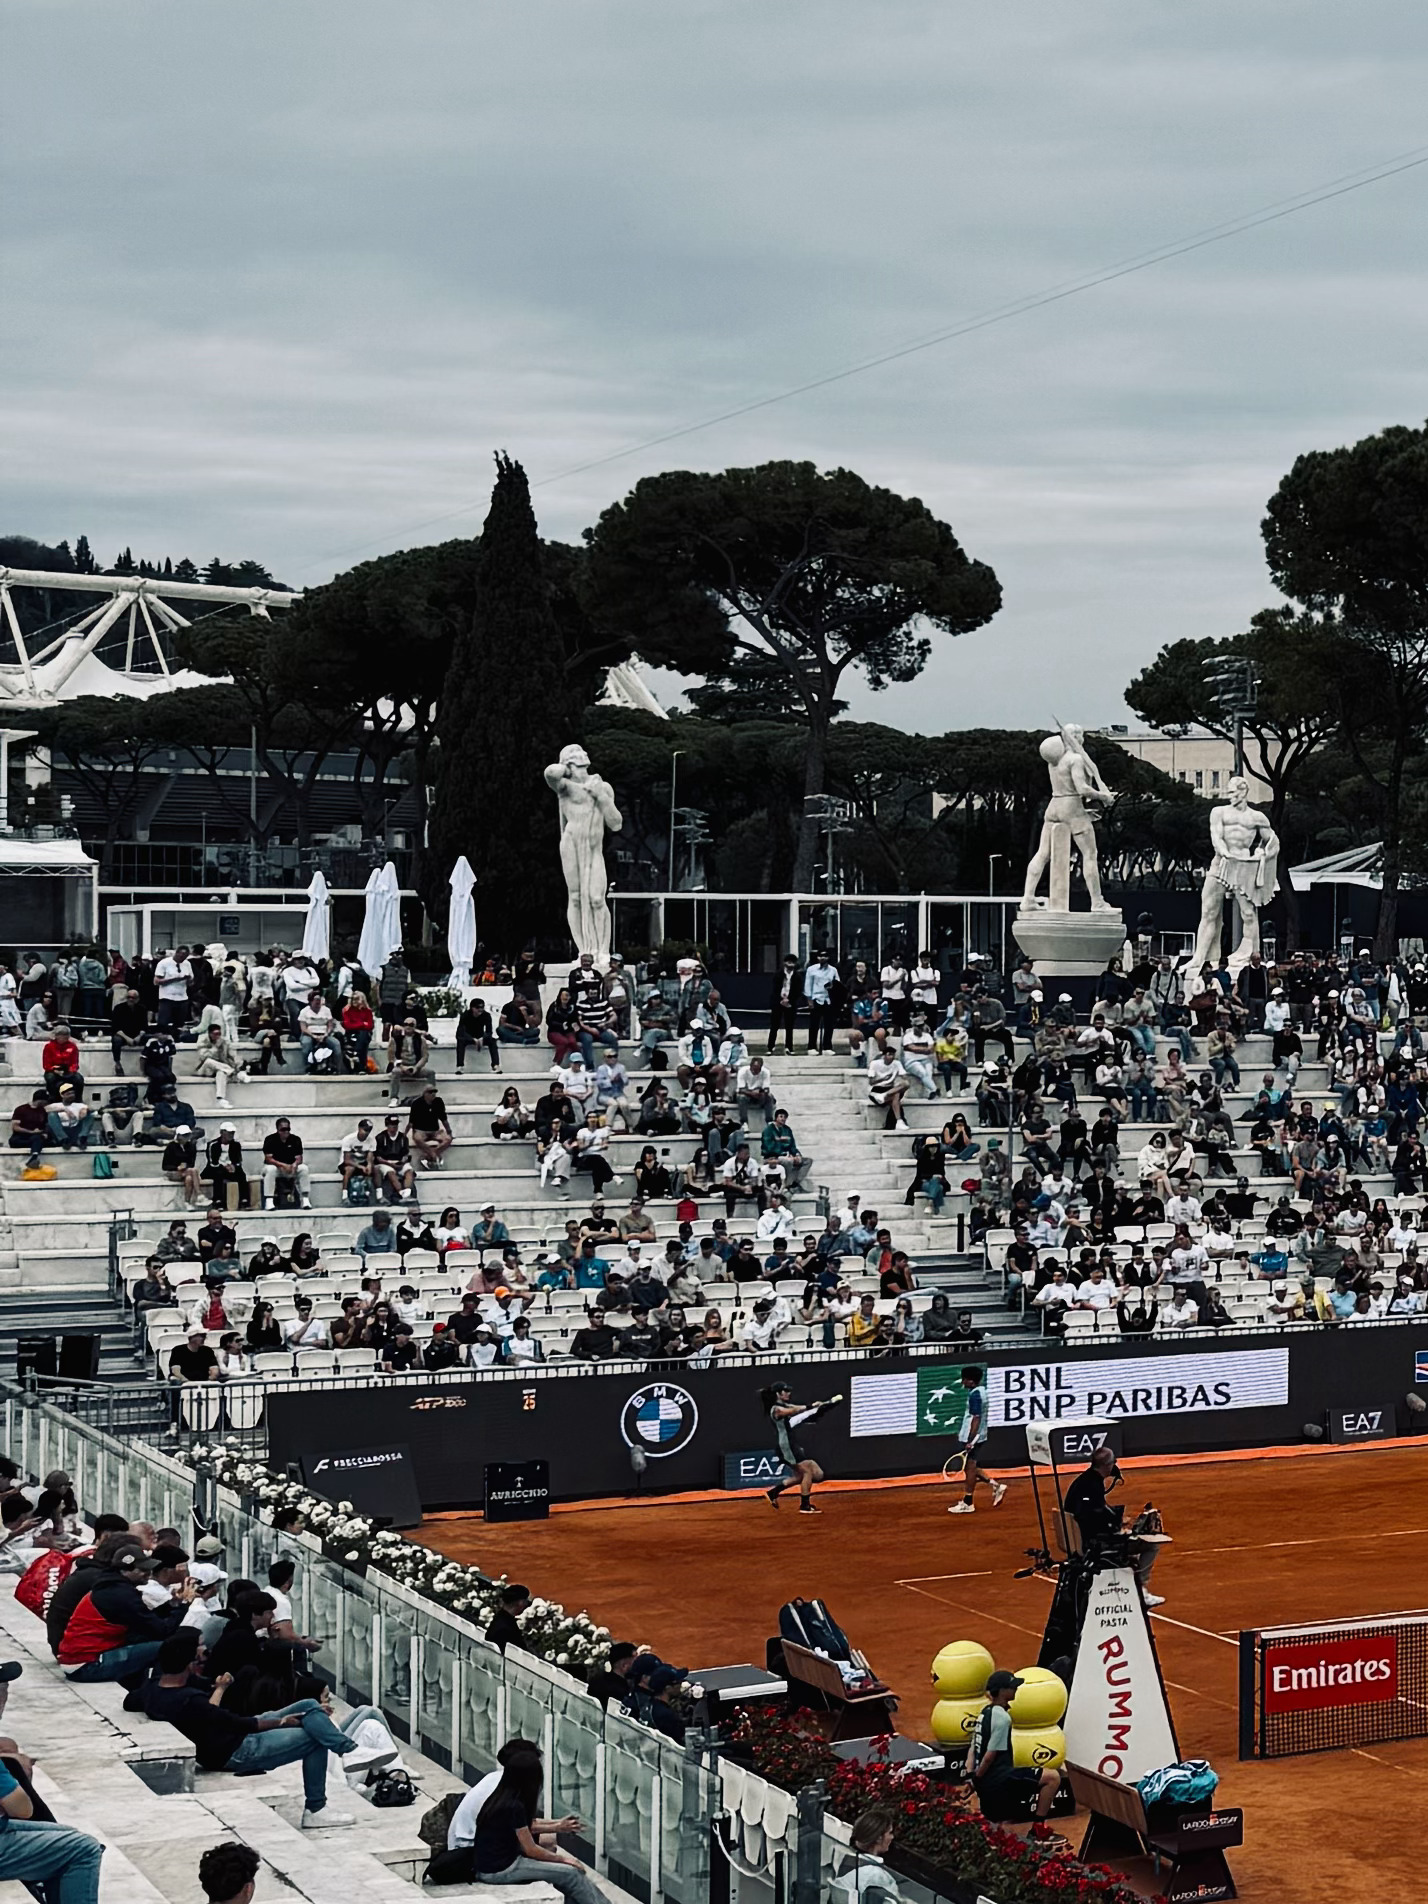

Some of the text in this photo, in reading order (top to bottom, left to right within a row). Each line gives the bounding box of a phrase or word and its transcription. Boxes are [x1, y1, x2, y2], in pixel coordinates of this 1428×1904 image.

[1004, 1366, 1073, 1394] BNL
[632, 1386, 689, 1409] BMW
[1004, 1382, 1232, 1422] BNP PARIBAS
[1342, 1411, 1382, 1432] EA7
[1064, 1432, 1108, 1453] EA7
[740, 1456, 785, 1477] EA7
[490, 1488, 548, 1500] AURICCHIO
[1094, 1603, 1133, 1615] OFFICIAL
[1100, 1617, 1128, 1627] PASTA
[1272, 1658, 1392, 1693] Emirates
[1097, 1634, 1133, 1780] RUMMO
